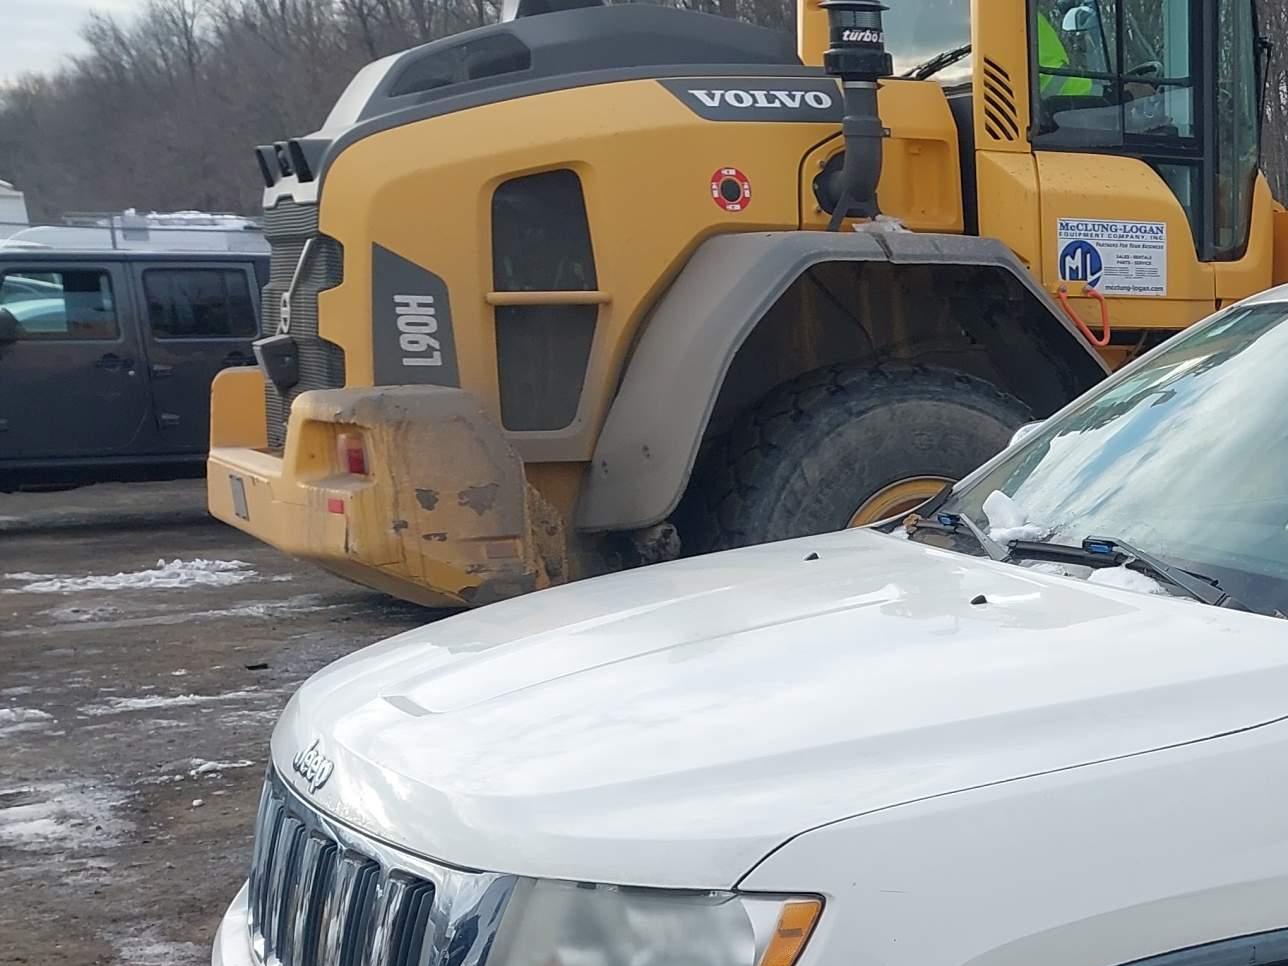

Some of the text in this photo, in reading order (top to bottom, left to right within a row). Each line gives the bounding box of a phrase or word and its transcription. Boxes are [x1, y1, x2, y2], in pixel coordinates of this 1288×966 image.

[842, 29, 878, 42] turbo
[687, 89, 832, 109] VOLVO
[1059, 222, 1164, 234] McCLUNG-LOGAN
[393, 294, 443, 366] L90H
[292, 738, 335, 794] Jeep
